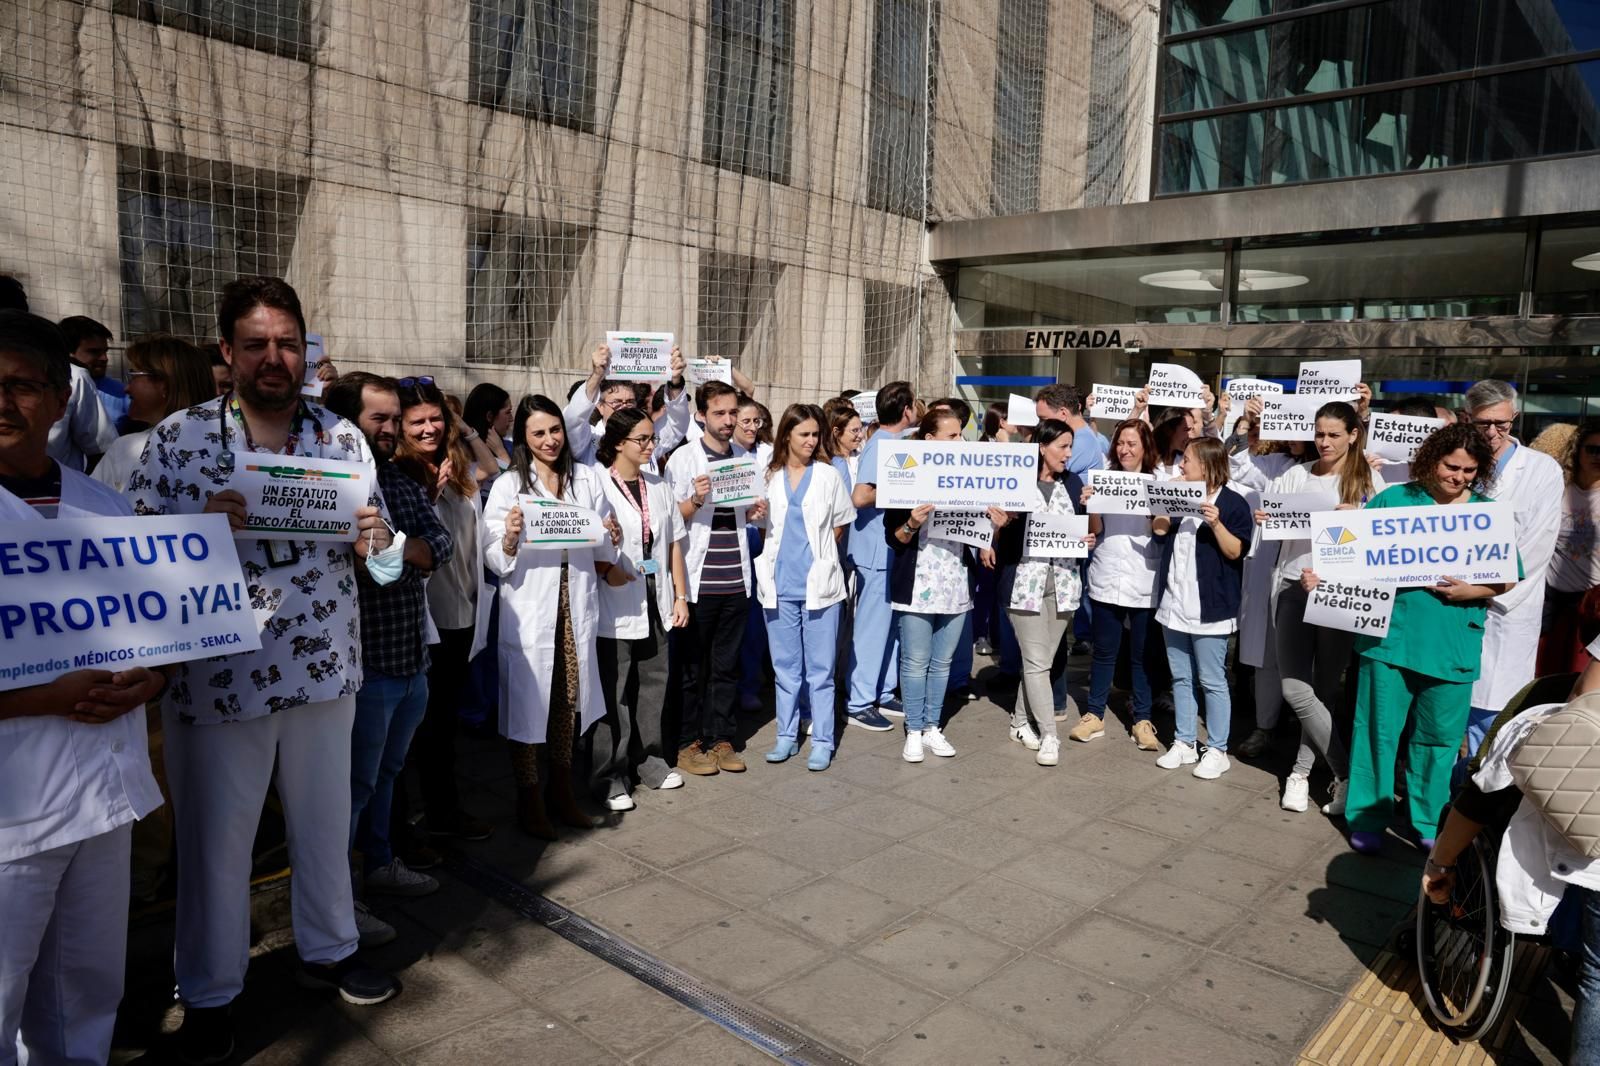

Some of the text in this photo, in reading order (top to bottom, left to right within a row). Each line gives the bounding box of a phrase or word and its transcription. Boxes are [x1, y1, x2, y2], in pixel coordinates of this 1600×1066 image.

[1025, 330, 1122, 349] ENTRADA
[1152, 369, 1169, 378] Por
[1301, 369, 1320, 377] Por
[1150, 380, 1188, 389] nuestro
[1229, 383, 1280, 393] Estatuto
[1096, 386, 1136, 397] Estatut
[1096, 396, 1129, 406] propio
[1264, 401, 1282, 410] Por
[1104, 406, 1132, 414] ¡ahor
[1263, 412, 1305, 420] nuestro
[1263, 422, 1316, 431] ESTATUT
[1374, 418, 1440, 434] Estatuto
[1372, 430, 1423, 444] Médico
[922, 452, 1035, 468] POR NUESTRO
[887, 471, 916, 479] SEMCA
[1092, 474, 1142, 486] Estatut
[937, 475, 1018, 490] ESTATUTO
[263, 485, 338, 500] UN ESTATUTO
[1092, 485, 1138, 497] Médico
[1147, 484, 1203, 498] Estatuto
[261, 495, 337, 511] PROPIO PARA
[1149, 497, 1188, 506] propio
[1263, 500, 1282, 509] Por
[290, 508, 303, 519] EL
[541, 511, 580, 519] MEJORA DE
[244, 512, 352, 531] ÉDICO/FACULTATIVO
[530, 518, 591, 527] LAS CONDICONES
[933, 518, 976, 527] propio
[1028, 519, 1046, 528] Por
[1265, 520, 1311, 529] ESTAT
[1372, 513, 1492, 536] ESTATUTO
[540, 526, 582, 535] LABORALES
[945, 526, 990, 543] ¡ahora!
[1027, 530, 1067, 539] nuestro
[1026, 539, 1086, 549] ESTATUTO
[0, 533, 209, 575] ESTATUTO
[1320, 546, 1356, 556] SEMCA
[1366, 543, 1510, 567] MÉDICO ¡YA!
[1399, 574, 1433, 582] MÉDICOS
[1473, 572, 1501, 580] SEMCA
[1317, 580, 1391, 601] Estatuto
[1314, 593, 1372, 612] Médico
[0, 582, 242, 640] PROPIO ¡YA!
[1354, 616, 1386, 630] ¡ya!
[74, 647, 134, 668] MÉDICOS
[138, 641, 192, 658] Canarias
[201, 632, 241, 649] SEMCA
